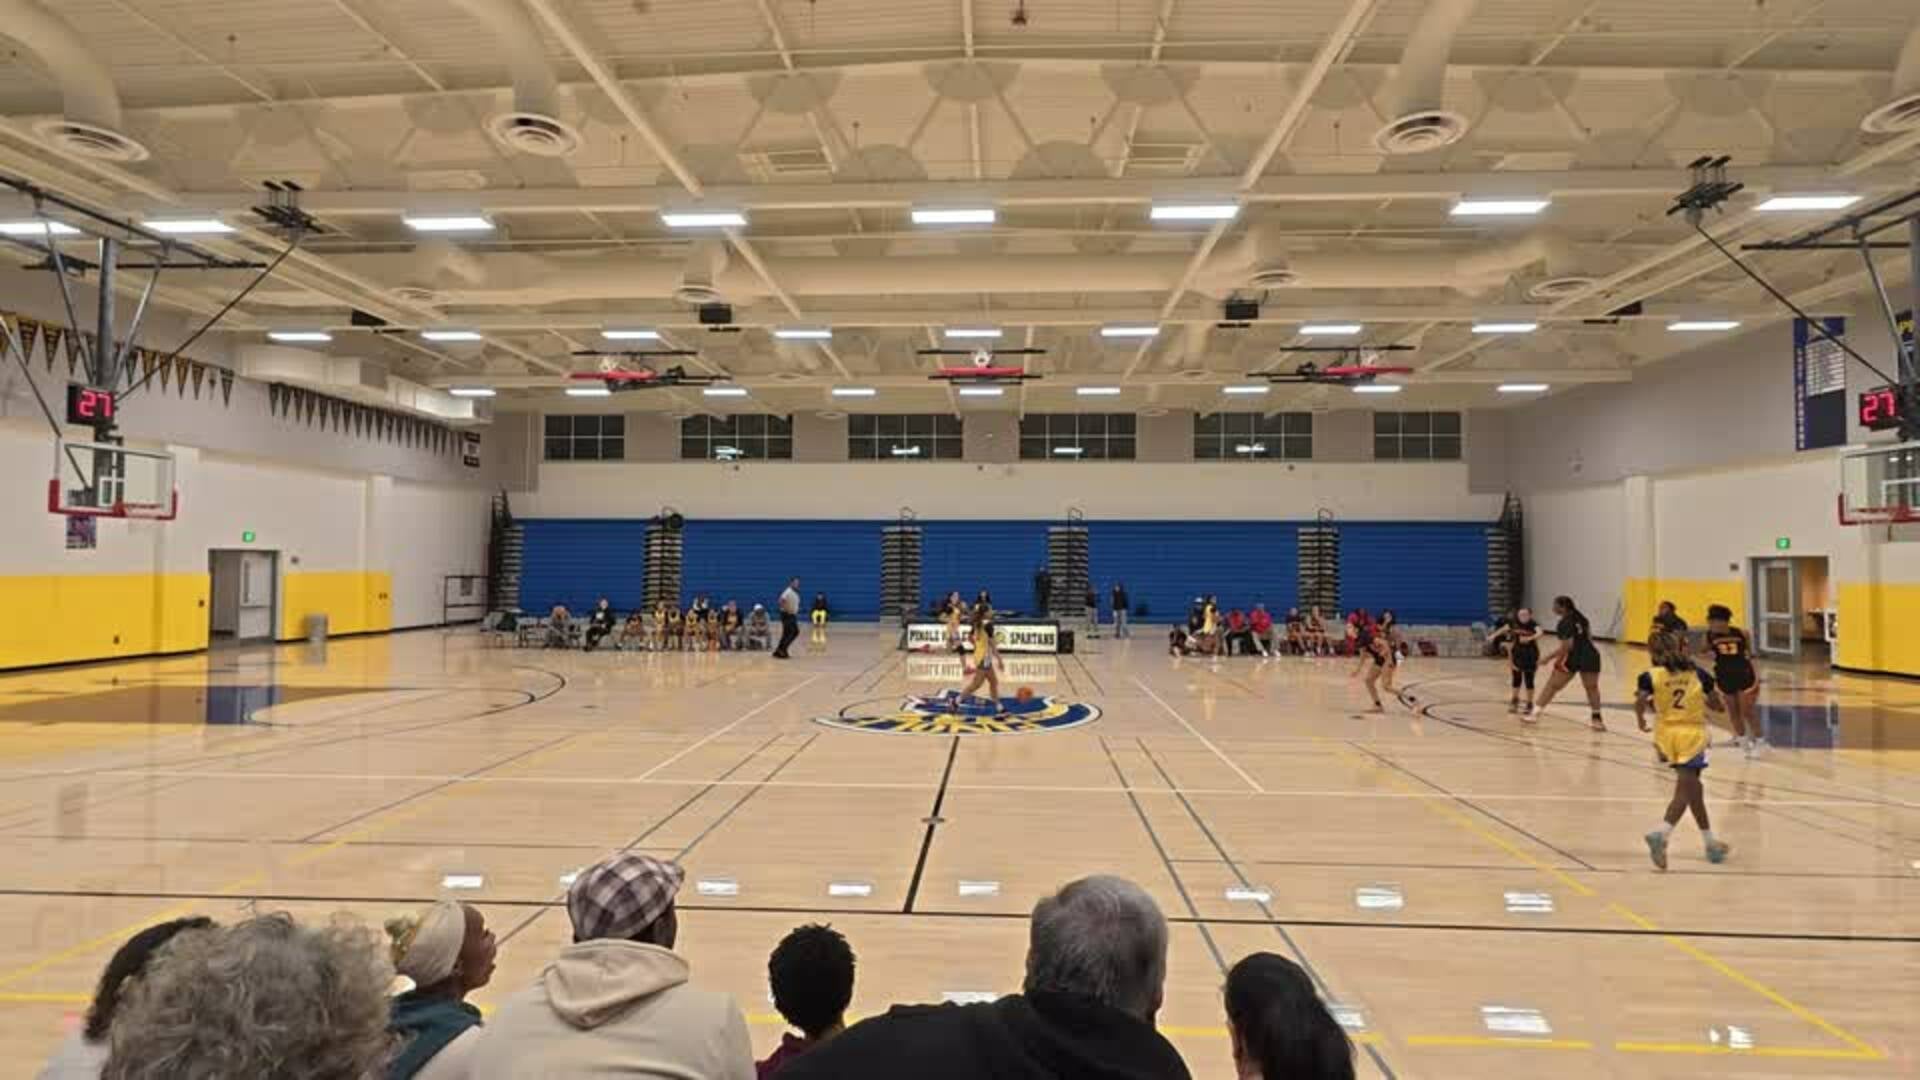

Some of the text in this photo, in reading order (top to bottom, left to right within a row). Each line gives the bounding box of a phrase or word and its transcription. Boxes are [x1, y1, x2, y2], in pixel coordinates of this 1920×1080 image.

[80, 391, 111, 417] 27
[1862, 392, 1895, 422] 27
[1010, 631, 1054, 645] SPARTANS
[1672, 689, 1686, 710] 2
